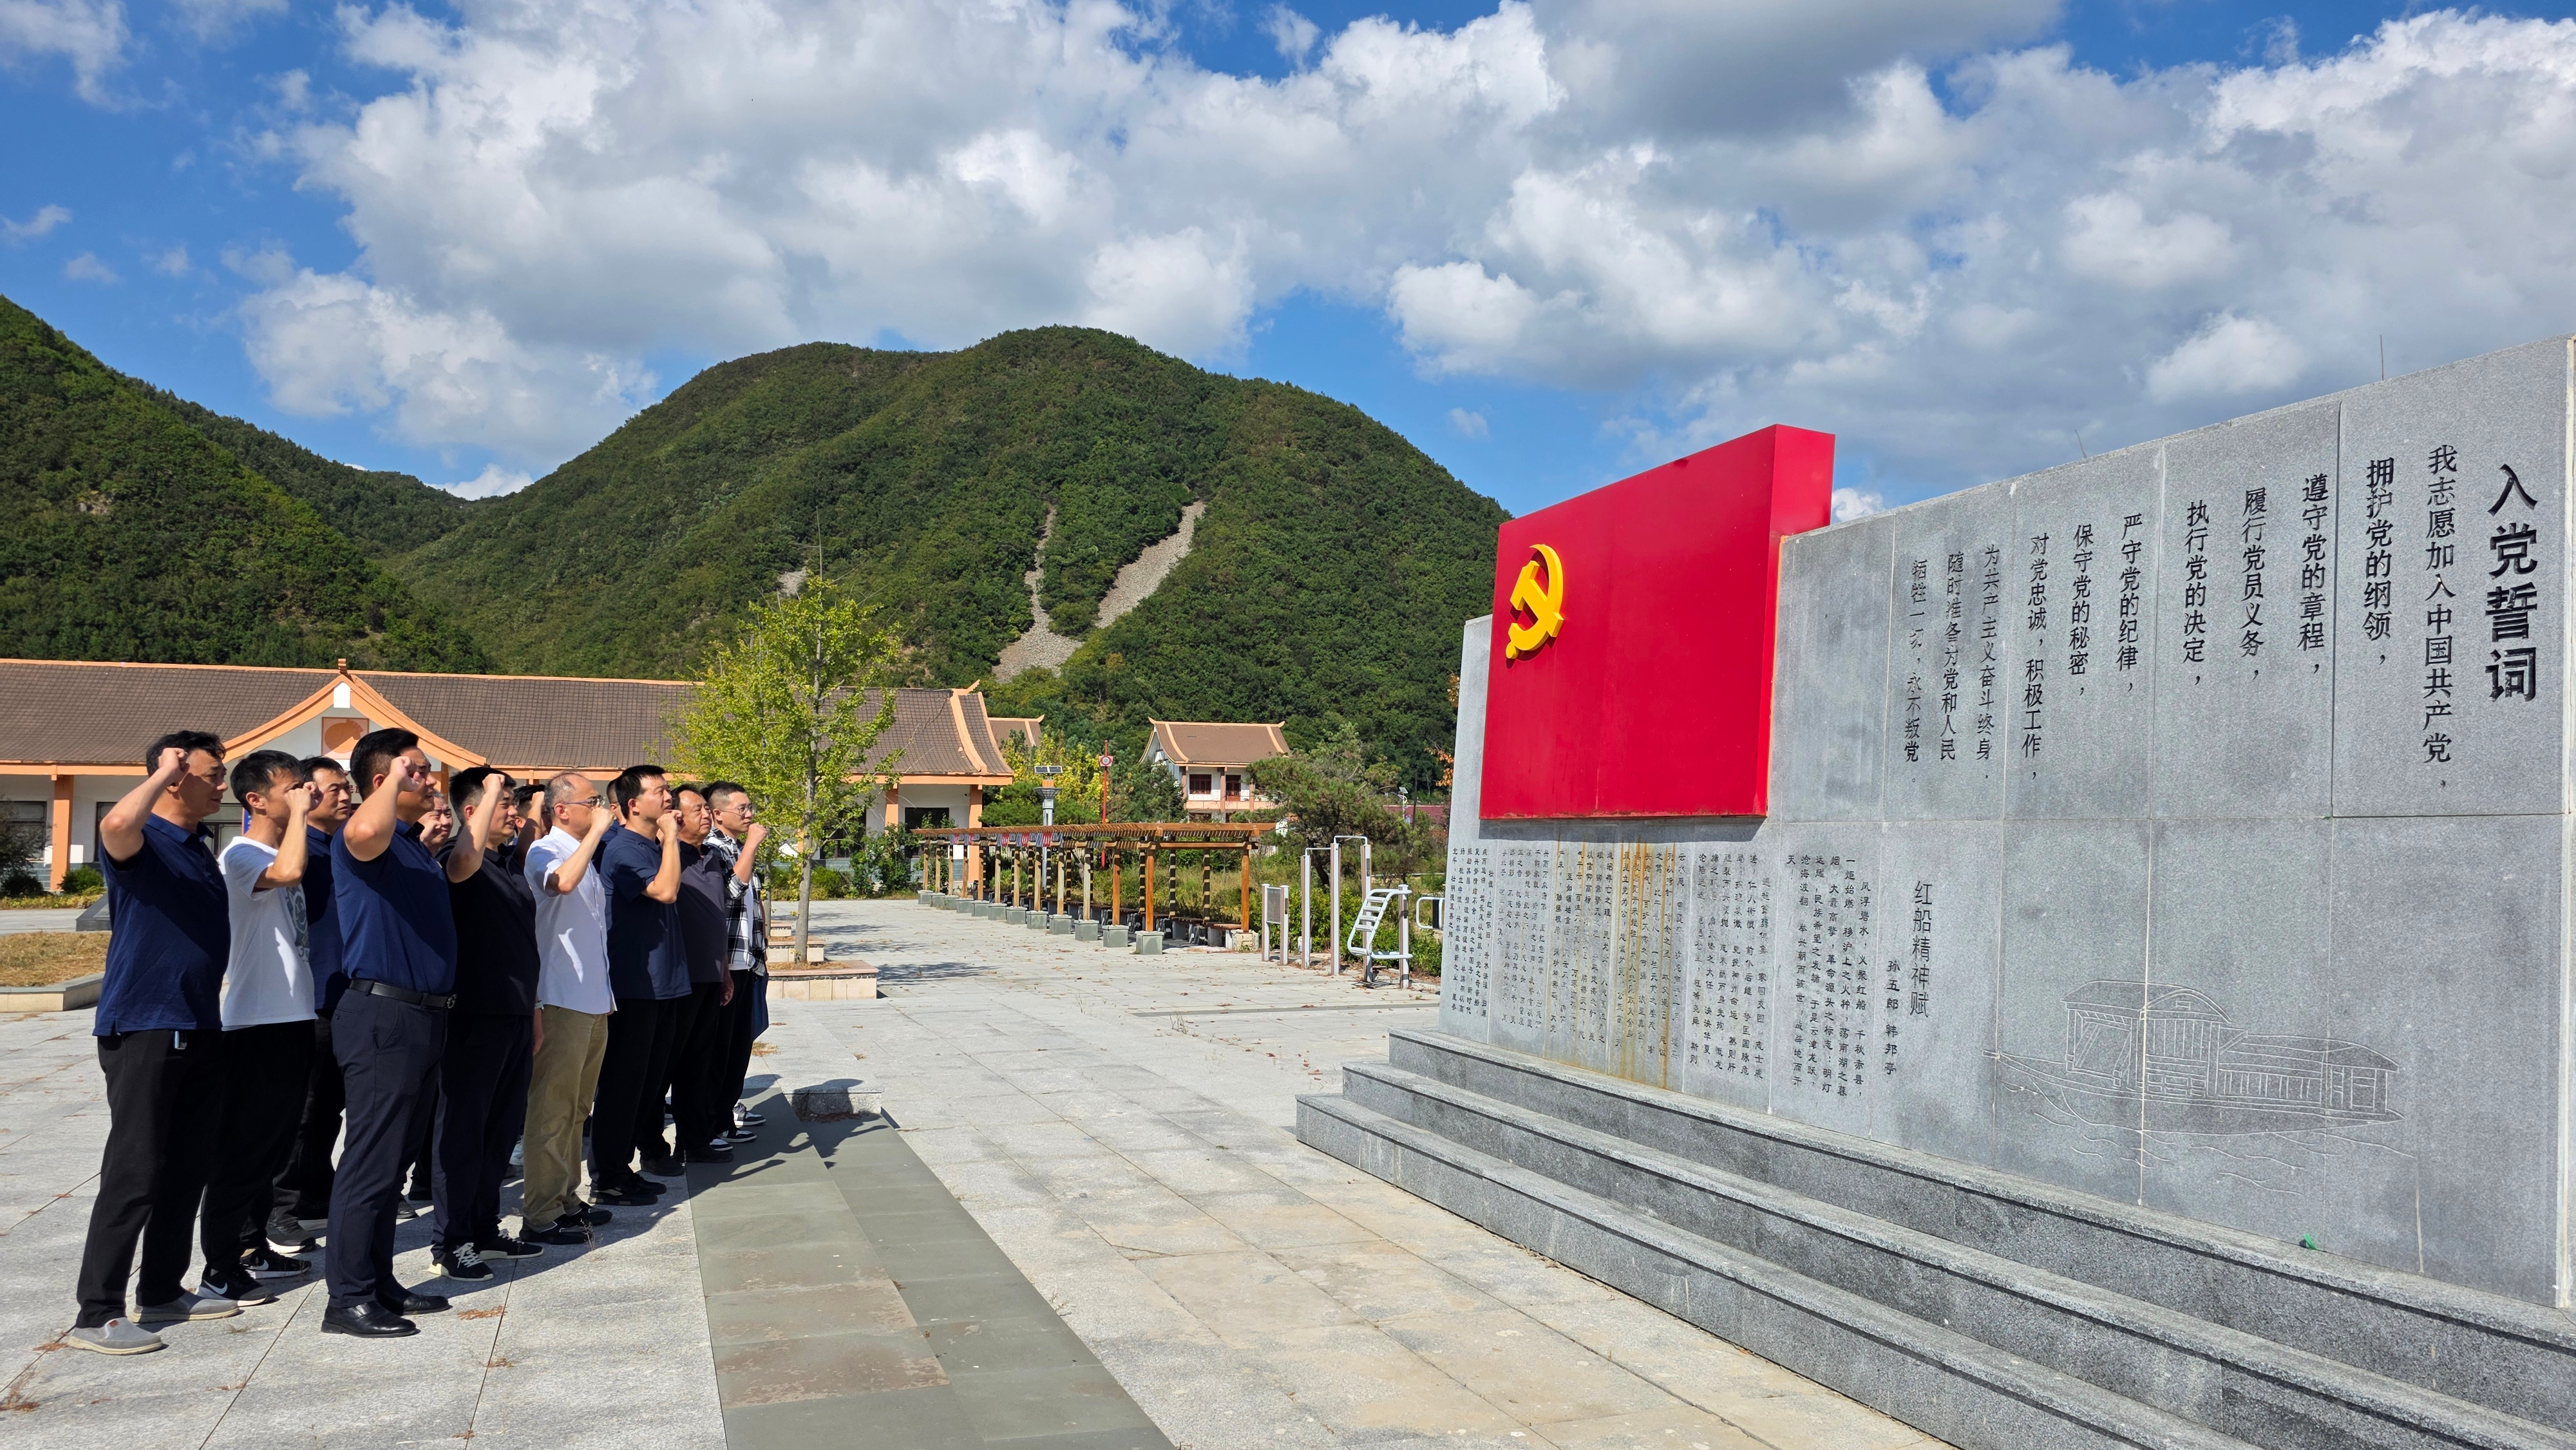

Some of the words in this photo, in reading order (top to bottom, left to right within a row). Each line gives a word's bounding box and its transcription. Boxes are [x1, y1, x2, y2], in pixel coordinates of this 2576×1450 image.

[2068, 523, 2094, 696] 保守党的秘密，
[2116, 513, 2143, 692] 严守党的纪律，
[2183, 500, 2210, 685] 执行党的决定，
[2239, 487, 2268, 680] 履行党员义务，
[2297, 473, 2329, 674] 遵守党的章程，
[2362, 457, 2394, 666] 拥护党的纲领，
[2422, 445, 2458, 789] 我志愿加入中国共产党，
[2485, 464, 2538, 702] 入党誓词
[1886, 960, 1900, 1011] 孙五郎
[1909, 880, 1933, 1019] 红船精神赋
[1884, 1024, 1899, 1075] 韩邦亭
